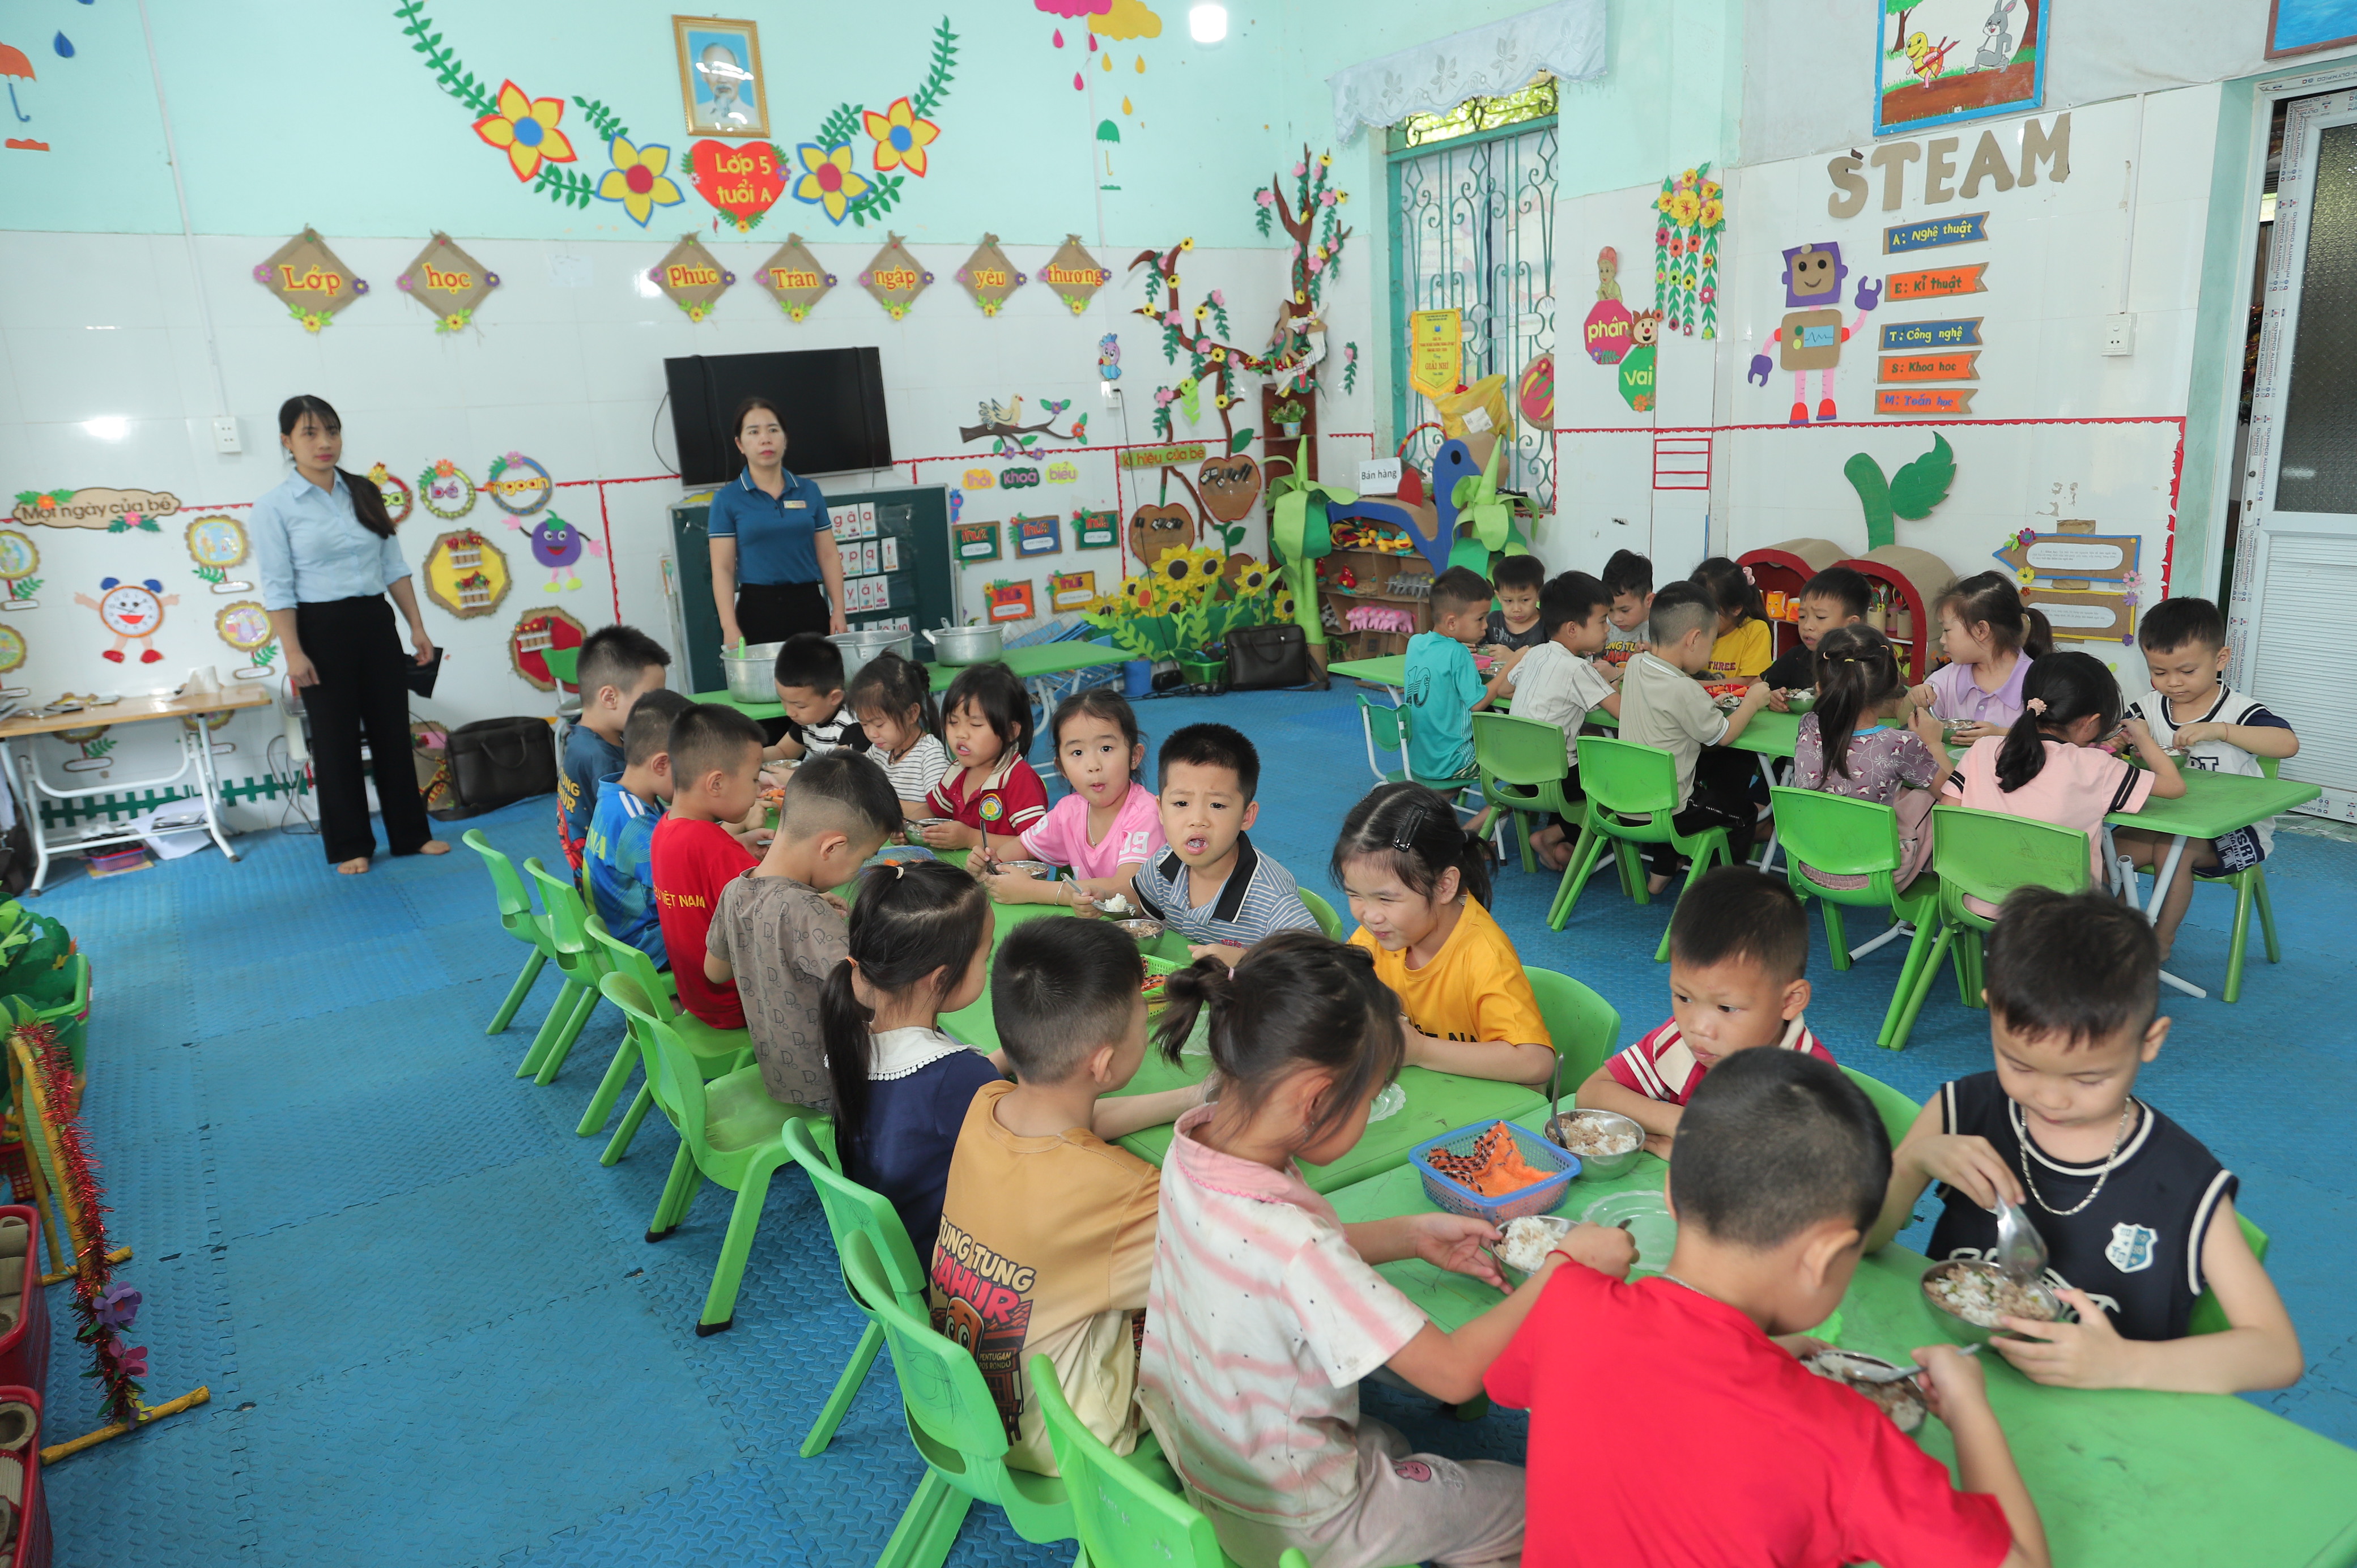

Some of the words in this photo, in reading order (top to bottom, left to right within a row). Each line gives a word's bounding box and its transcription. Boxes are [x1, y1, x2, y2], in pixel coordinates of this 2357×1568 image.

[715, 152, 755, 176] Lớp
[758, 155, 772, 175] 5
[1827, 112, 2071, 218] STEAM
[716, 178, 755, 204] tuổi
[760, 187, 773, 202] A
[1911, 225, 1939, 242] Nghệ
[1942, 220, 1973, 238] thuật
[279, 264, 342, 297] Lớp
[422, 262, 472, 295] học
[769, 267, 819, 290] Tràn
[873, 265, 916, 291] ngập
[973, 267, 1006, 289] yêu
[1930, 275, 1963, 293] thuật
[1587, 315, 1630, 343] phân
[1906, 327, 1933, 344] Công
[1938, 326, 1964, 342] nghệ
[1623, 365, 1653, 386] vai
[1908, 361, 1934, 372] Khoa
[1904, 393, 1931, 406] Toán
[1137, 452, 1162, 468] hiệu
[1166, 448, 1187, 461] của
[1189, 446, 1205, 459] bé
[1049, 461, 1077, 481] biểu
[1361, 470, 1376, 480] Bán
[1377, 468, 1397, 479] hàng
[429, 480, 459, 499] bé
[493, 476, 550, 497] ngoan
[61, 502, 107, 520] ngày
[109, 497, 144, 513] của
[148, 497, 172, 512] bé
[1707, 661, 1737, 671] THREE
[678, 894, 706, 909] NAM
[971, 1242, 1037, 1294] TUNG
